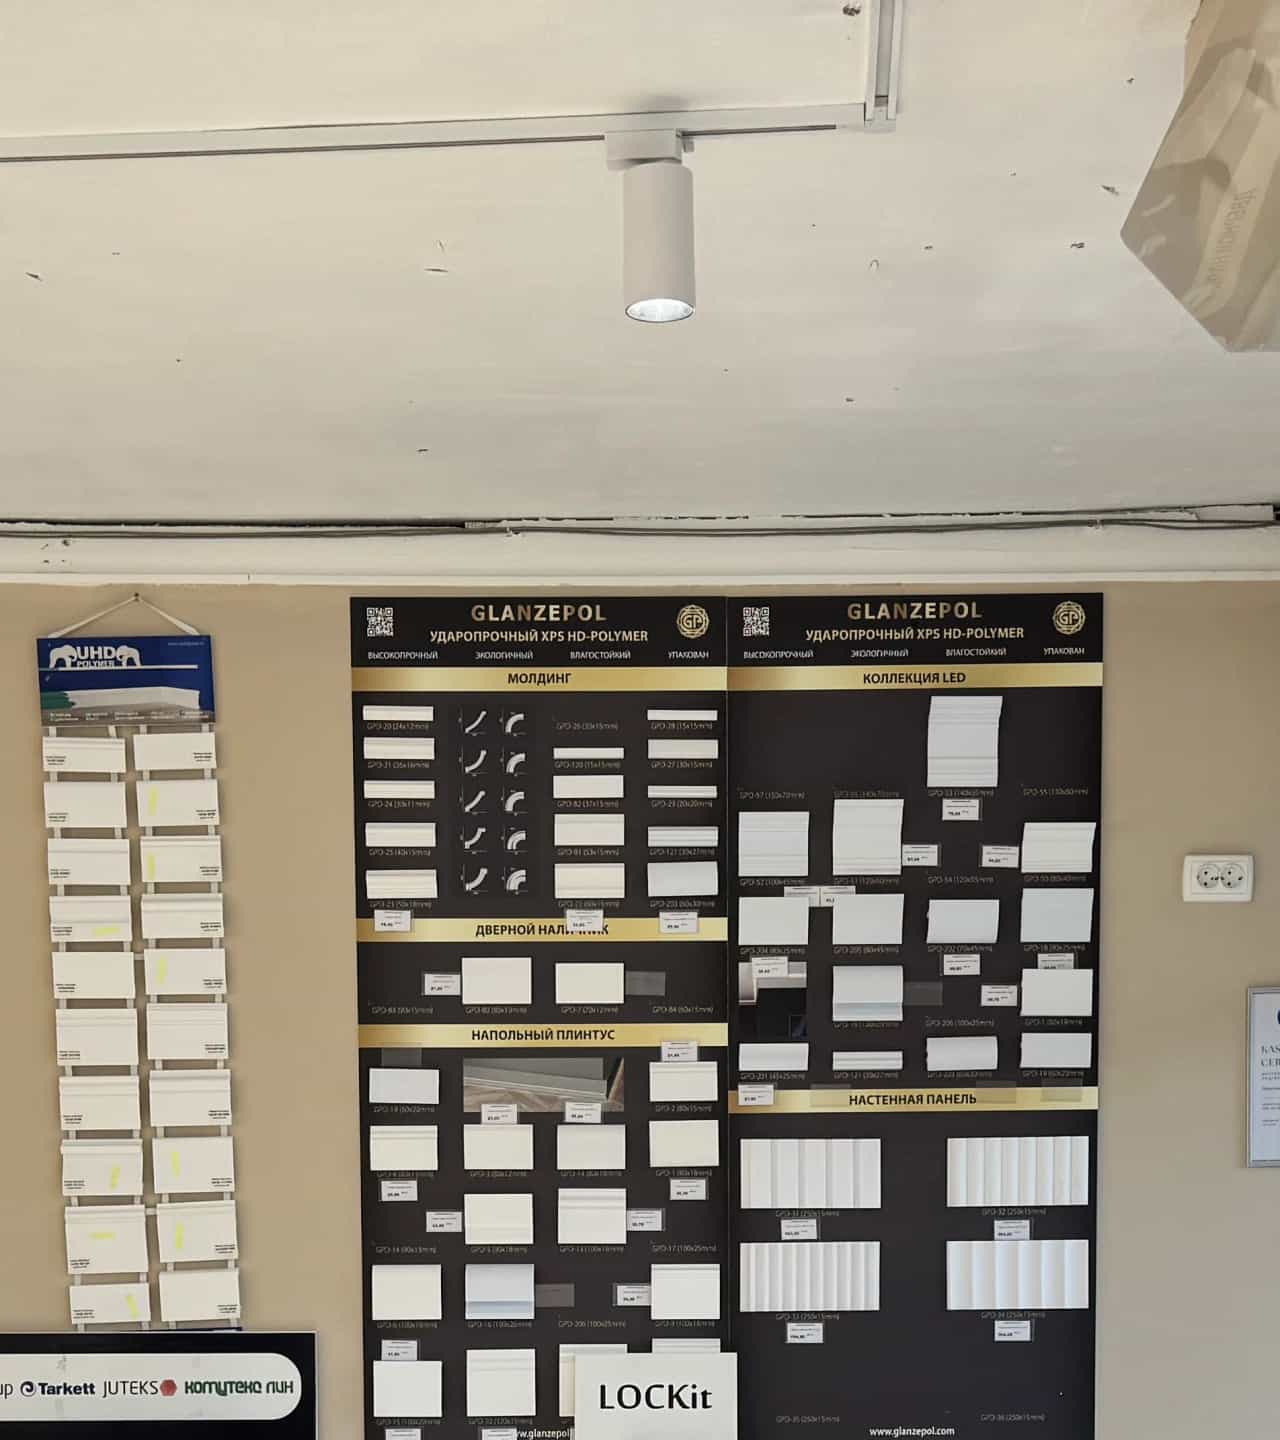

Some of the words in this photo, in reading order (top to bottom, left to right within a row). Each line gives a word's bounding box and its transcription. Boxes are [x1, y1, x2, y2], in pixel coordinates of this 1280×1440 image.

[470, 604, 607, 622] GLANZEPOL
[847, 601, 983, 620] GLANZEPOL
[429, 629, 539, 646] УДАРОПРОЧНЫЙ
[541, 631, 565, 642] XPS
[567, 630, 649, 642] HD-POLYMER
[805, 626, 915, 643] УДАРОПРОЧНЫЙ
[916, 628, 941, 640] XPS
[943, 627, 1025, 640] HD-POLYMER
[76, 645, 114, 660] UHD
[76, 660, 115, 668] POLYMER
[507, 672, 572, 686] МОЛДИНГ
[862, 672, 940, 687] КОЛЛЕКЦИЯ
[942, 672, 966, 684] LED
[474, 922, 535, 938] ДВЕРНОЙ
[538, 924, 609, 937] НАЛИК
[471, 1027, 554, 1042] НАПОЛЬНЫЙ
[556, 1029, 615, 1041] ПЛИНТУС
[848, 1093, 924, 1106] НАСТЕННАЯ
[926, 1092, 977, 1106] ПАНЕЛЬ
[38, 1381, 96, 1396] Tarkett
[102, 1380, 159, 1397] JUTEKS
[599, 1383, 713, 1410] LOCKit
[869, 1425, 955, 1438] www.glanzepol.com
